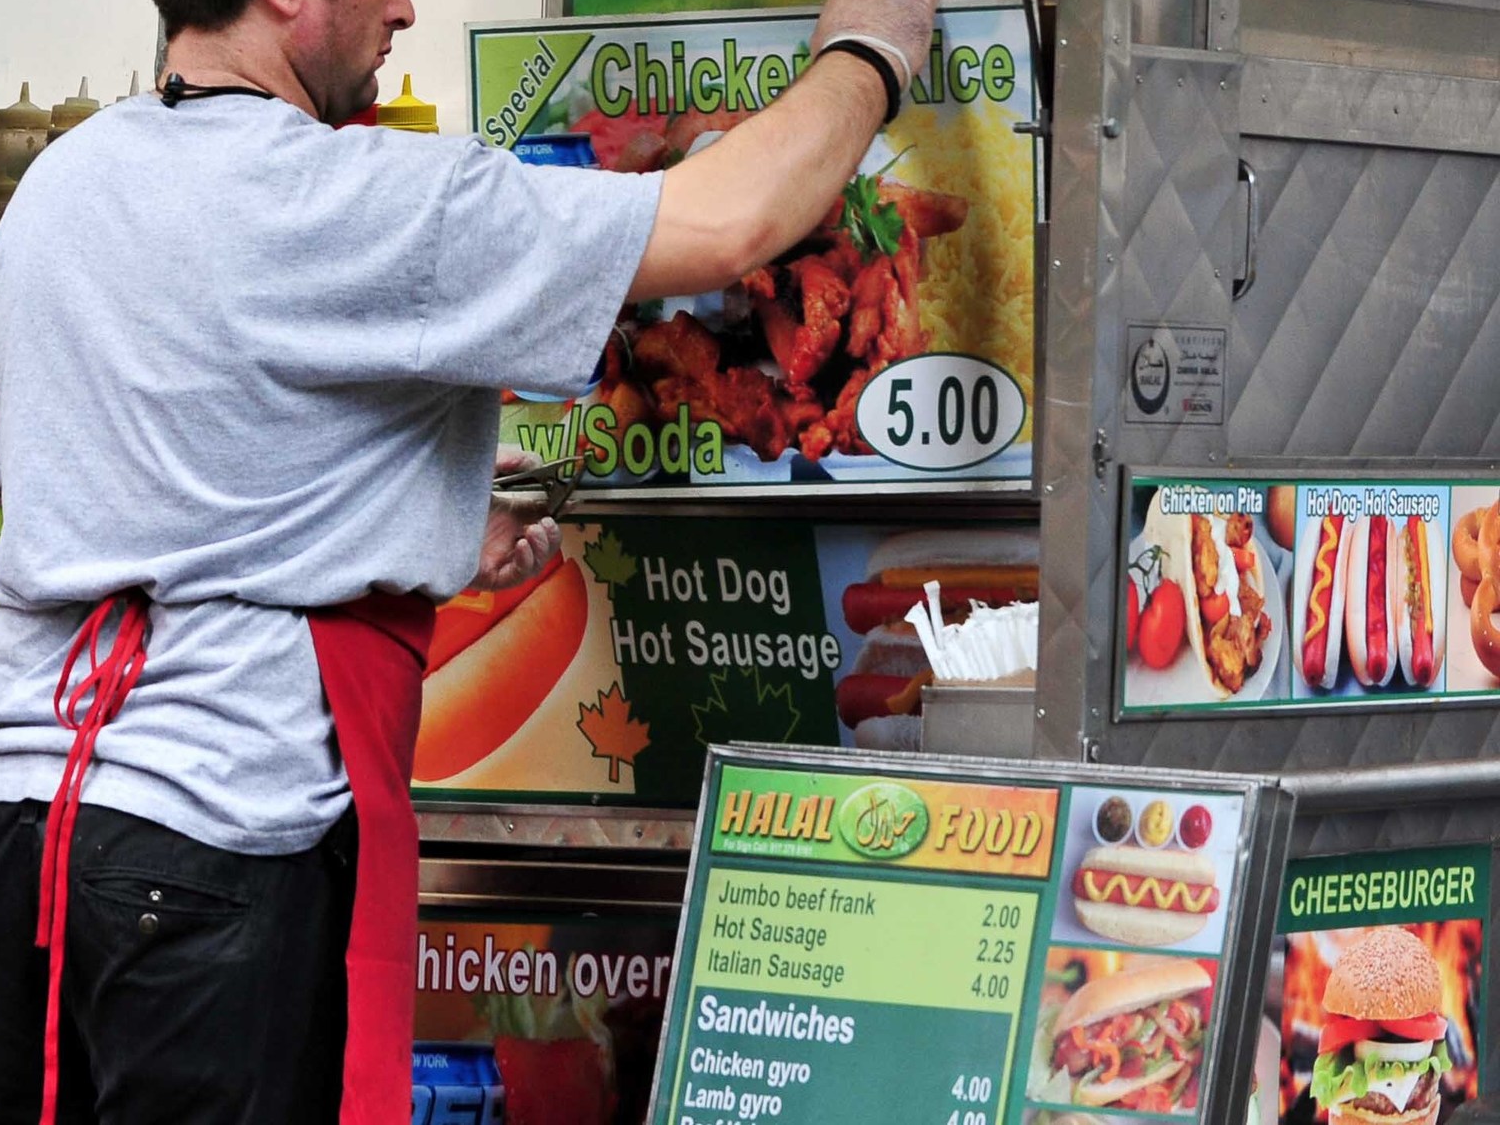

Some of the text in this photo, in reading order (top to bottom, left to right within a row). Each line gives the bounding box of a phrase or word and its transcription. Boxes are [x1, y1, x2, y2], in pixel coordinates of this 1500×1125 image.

[912, 29, 1017, 106] ice
[484, 33, 559, 152] Special
[886, 375, 1000, 448] 5.00
[517, 403, 726, 477] w/Soda
[1159, 487, 1263, 514] Chicken on Pita
[1307, 488, 1330, 517] Hot
[1364, 489, 1386, 516] Hot
[1388, 491, 1440, 523] Sausage
[643, 557, 792, 616] Hot Dog
[611, 619, 841, 681] Hot Sausage
[720, 789, 836, 844] HALAL
[935, 803, 1044, 857] FOOD
[718, 880, 876, 916] Jumbo beef frank
[1289, 866, 1476, 917] CHEESEBURGER
[713, 914, 828, 952] Hot Sausage
[981, 903, 1021, 929] 2.00
[417, 933, 670, 999] hicken over
[707, 948, 846, 988] Italian Sausage
[975, 939, 1016, 964] 2.25
[971, 974, 1009, 1000] 4.00
[697, 994, 856, 1045] Sandwiches
[689, 1046, 811, 1088] Chicken gyro
[950, 1075, 992, 1103] 4.00
[683, 1081, 783, 1121] Lamb gyro
